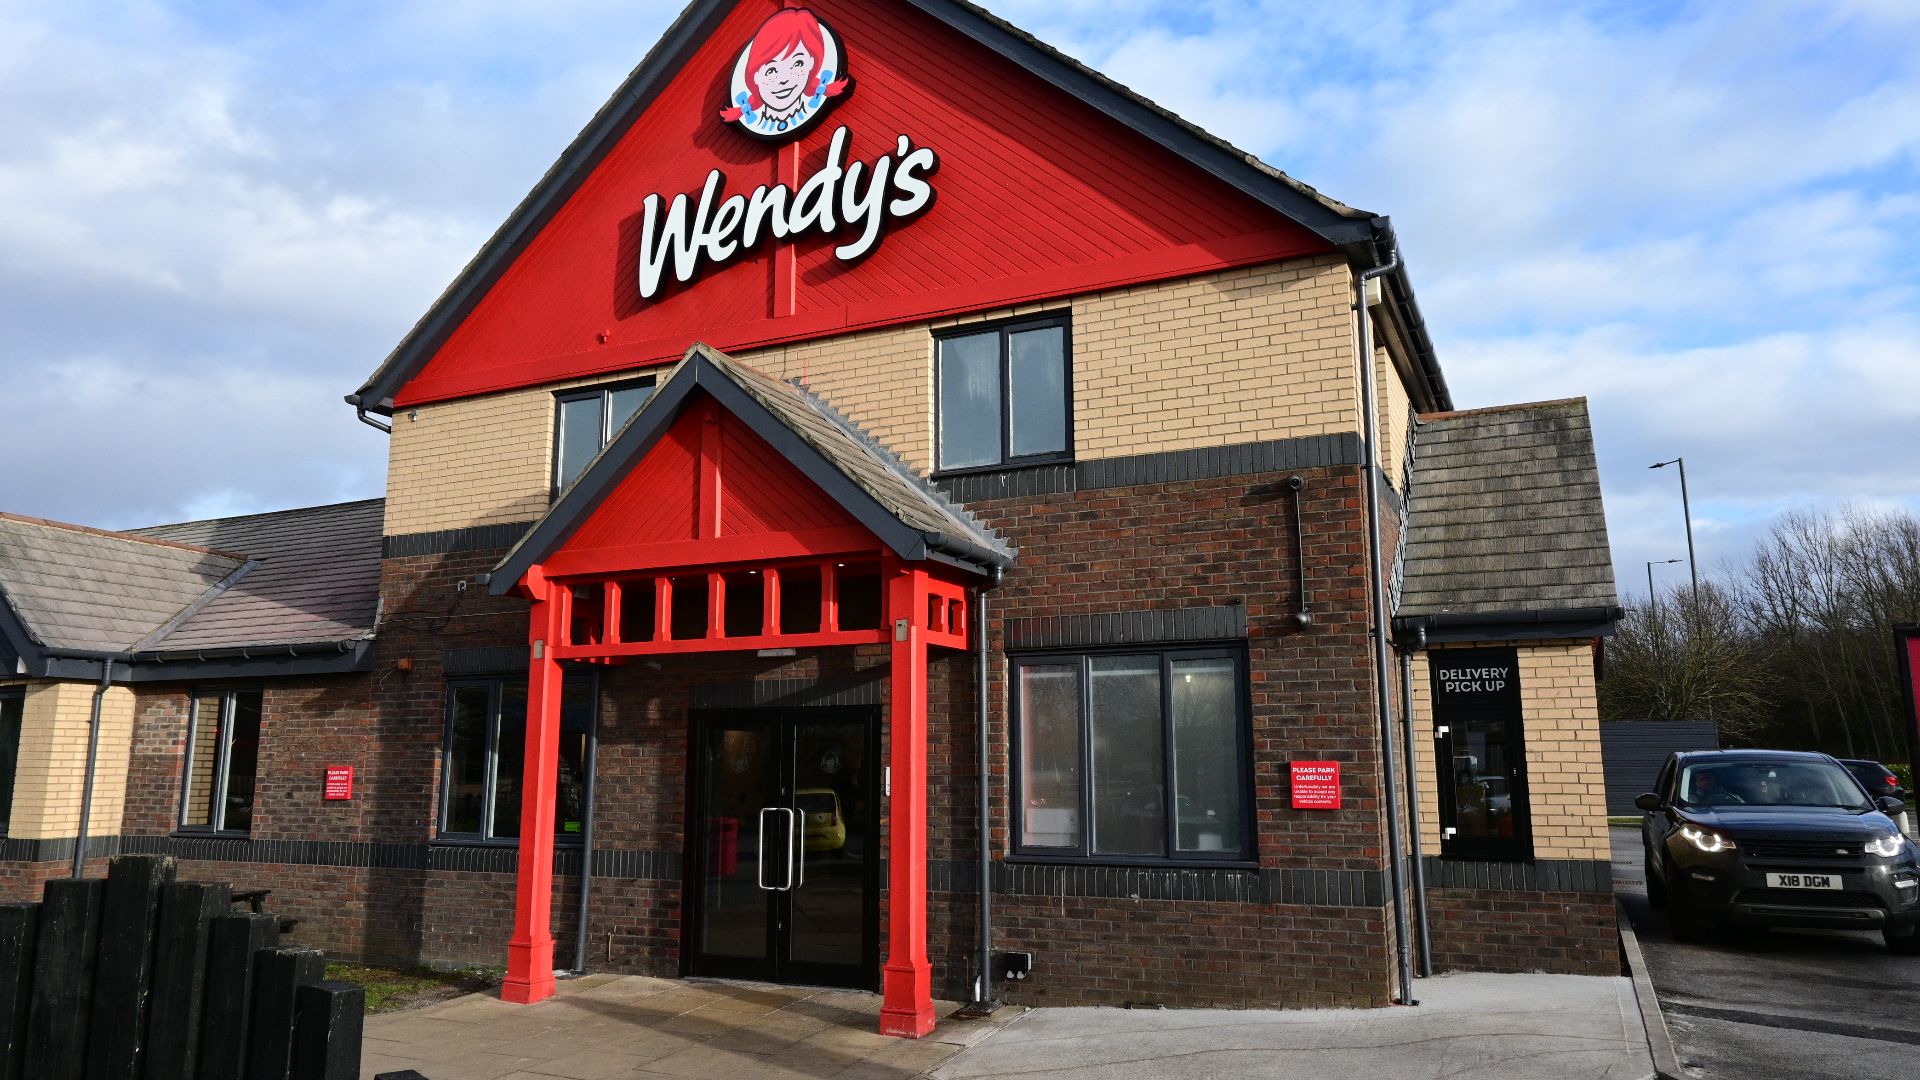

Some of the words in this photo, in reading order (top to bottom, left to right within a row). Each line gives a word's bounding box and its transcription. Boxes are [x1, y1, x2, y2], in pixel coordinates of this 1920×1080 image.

[638, 125, 936, 299] Wendy's
[1439, 667, 1509, 680] DELIVERY
[1445, 681, 1482, 693] PICK
[1485, 680, 1506, 692] UP
[1778, 875, 1800, 887] X18
[1803, 876, 1831, 887] DGM
